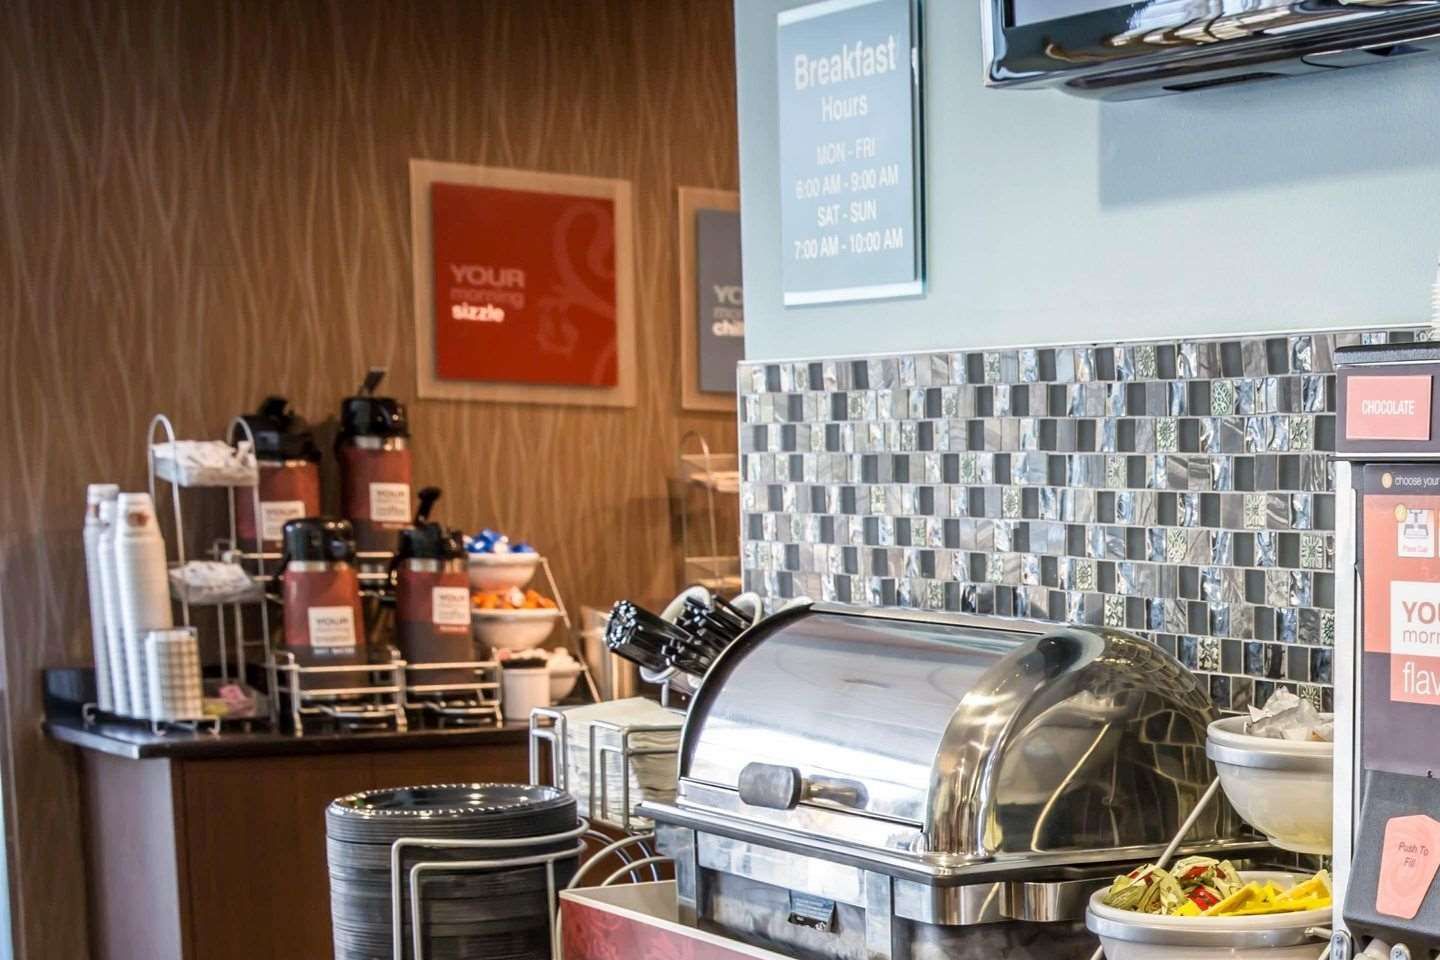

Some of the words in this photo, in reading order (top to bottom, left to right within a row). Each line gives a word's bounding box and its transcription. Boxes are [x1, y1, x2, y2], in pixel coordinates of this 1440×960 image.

[795, 34, 896, 90] Breakfast
[822, 95, 868, 120] Hours
[816, 141, 847, 165] MON
[855, 137, 876, 159] FRI
[822, 174, 841, 195] AM
[851, 169, 877, 191] 9:00
[880, 164, 899, 186] AM
[817, 204, 840, 227] SAT
[850, 200, 877, 223] SUN
[794, 239, 818, 260] 7:00
[820, 234, 839, 256] AM
[849, 231, 880, 254] 10:00
[883, 227, 904, 249] AM
[450, 263, 525, 287] YOUR
[713, 285, 743, 304] YO
[451, 301, 505, 322] sizzle
[1361, 399, 1415, 416] CHOCOLATE
[1394, 475, 1422, 486] choose
[1423, 477, 1439, 488] your
[1399, 841, 1418, 852] Push
[1420, 845, 1429, 856] To
[1404, 857, 1417, 867] Fill
